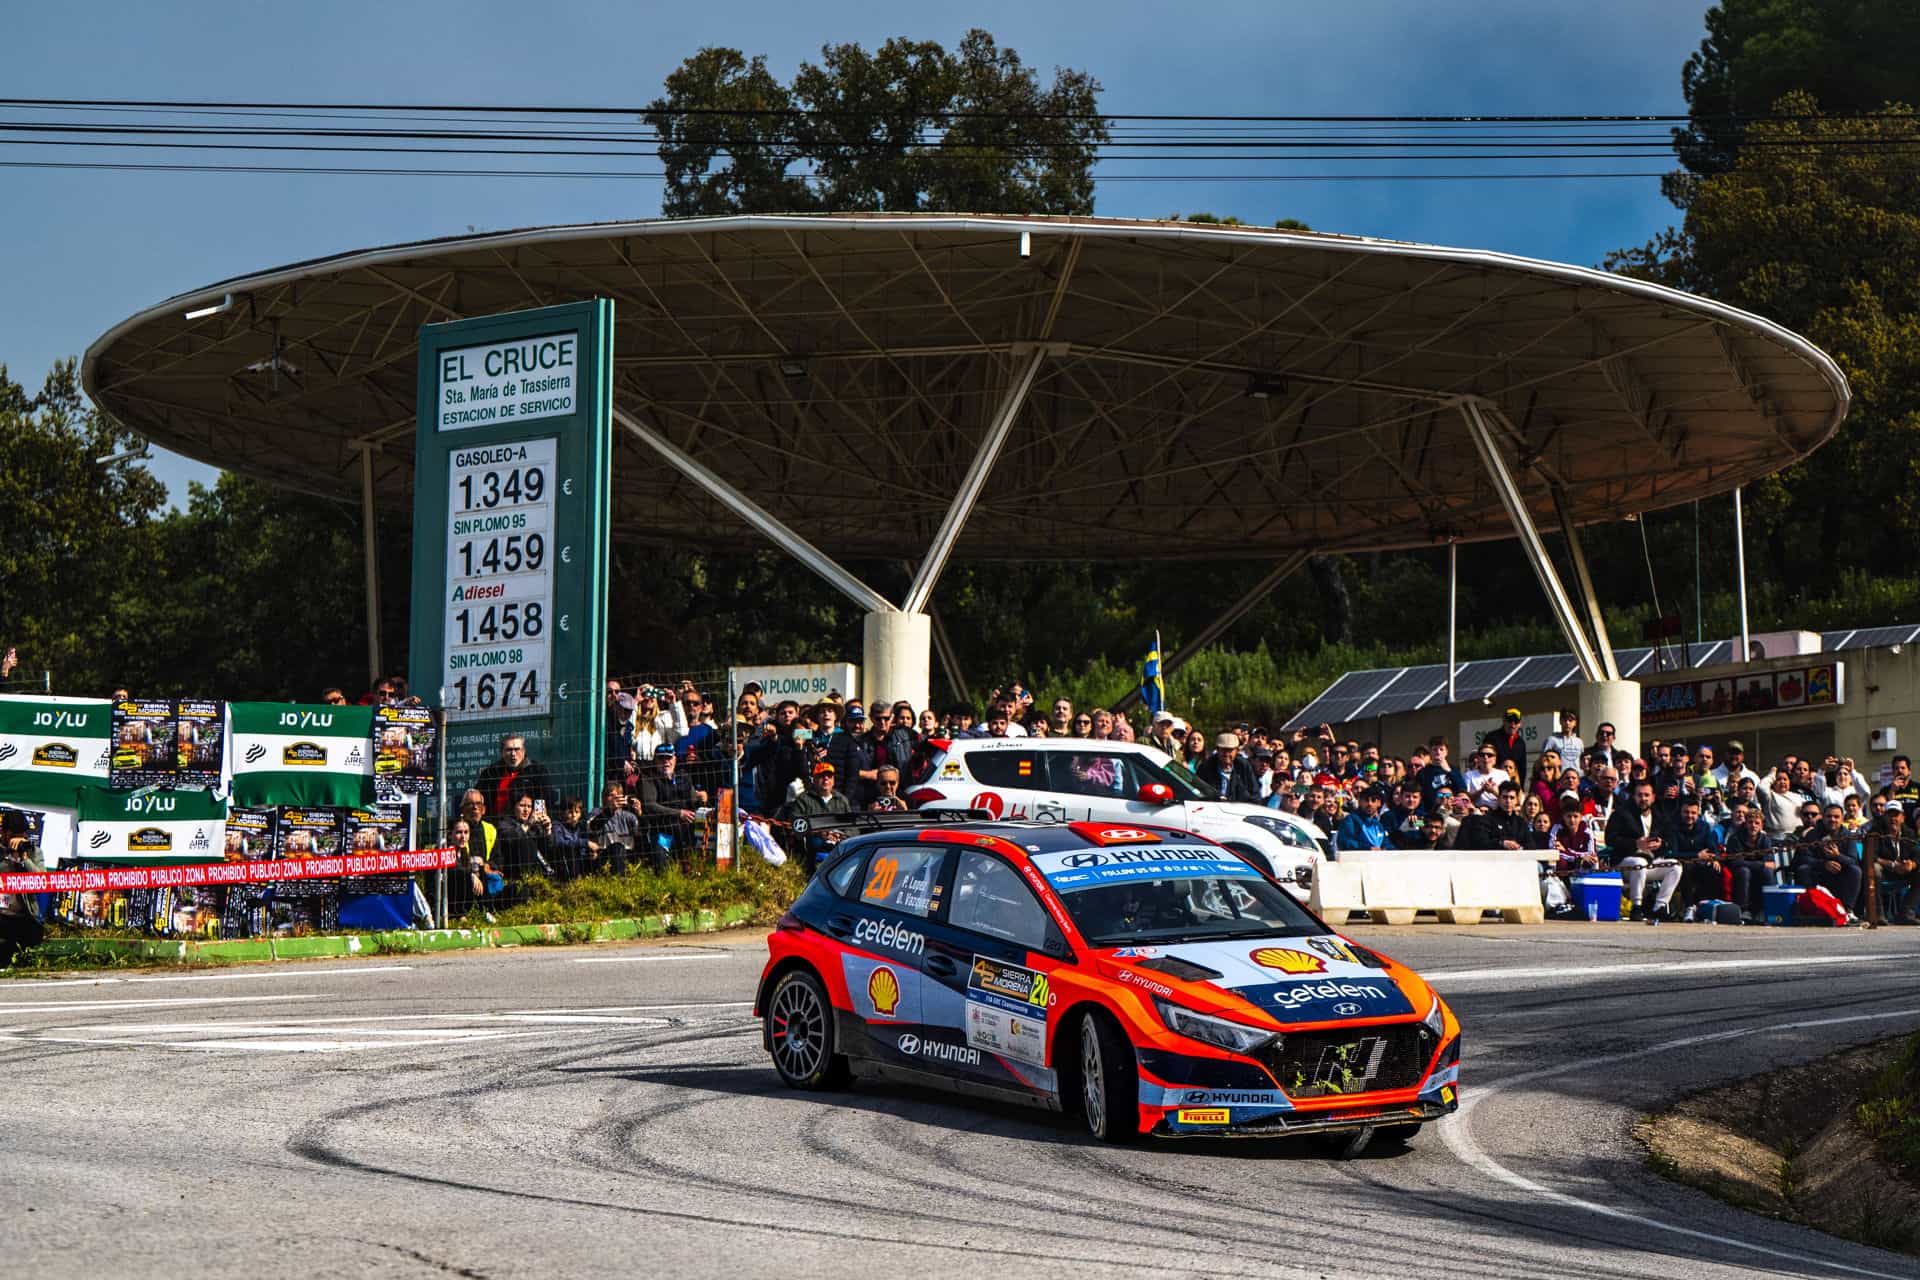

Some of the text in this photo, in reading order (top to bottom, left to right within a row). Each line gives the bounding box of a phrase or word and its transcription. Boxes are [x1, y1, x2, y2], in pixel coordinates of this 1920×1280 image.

[443, 339, 574, 383] EL CRUCE
[445, 375, 571, 405] Sta. María de Trassierra
[443, 396, 571, 425] ESTACION DE SERVICIO
[456, 445, 527, 468] GASOLEO-A
[459, 467, 573, 510] 1.349 €
[454, 513, 526, 535] SIN PLOMO 95
[459, 533, 571, 577] 1.459 €
[452, 583, 504, 602] Adiesel
[456, 602, 569, 644] 1.458 €
[449, 648, 522, 669] SIN PLOMO 98
[453, 670, 568, 711] 1.674 €
[770, 678, 809, 694] PLOMO
[812, 677, 827, 692] 98
[33, 711, 87, 728] JOYLU
[280, 711, 332, 728] JOYLU
[1525, 726, 1538, 741] 95
[124, 795, 176, 814] JOYLU
[1111, 848, 1221, 863] HYUNDAI
[7, 875, 47, 890] PROHIBIDO
[50, 873, 82, 889] PUBLICO
[85, 872, 106, 888] ZONA
[109, 871, 148, 886] PROHIBIDO
[151, 869, 182, 885] PUBLICO
[186, 867, 205, 883] ZONA
[208, 865, 246, 882] PROHIBIDO
[250, 863, 280, 878] PUBLICO
[283, 861, 303, 877] ZONA
[305, 859, 343, 875] PROHIBIDO
[346, 857, 377, 873] PUBLICO
[379, 855, 398, 870] ZONA
[401, 852, 438, 868] PROHIBIDO
[864, 857, 899, 900] 20
[853, 917, 925, 955] cetelem
[993, 977, 1029, 994] MORENA
[1001, 968, 1032, 985] SIERRA
[1132, 976, 1174, 997] HYUNDAI
[1029, 974, 1050, 1007] 20
[1273, 980, 1387, 1009] cetelem
[923, 1040, 981, 1066] HYUNDAI
[1212, 1093, 1274, 1103] HYUNDAI
[1183, 1111, 1225, 1120] PIRELLI
